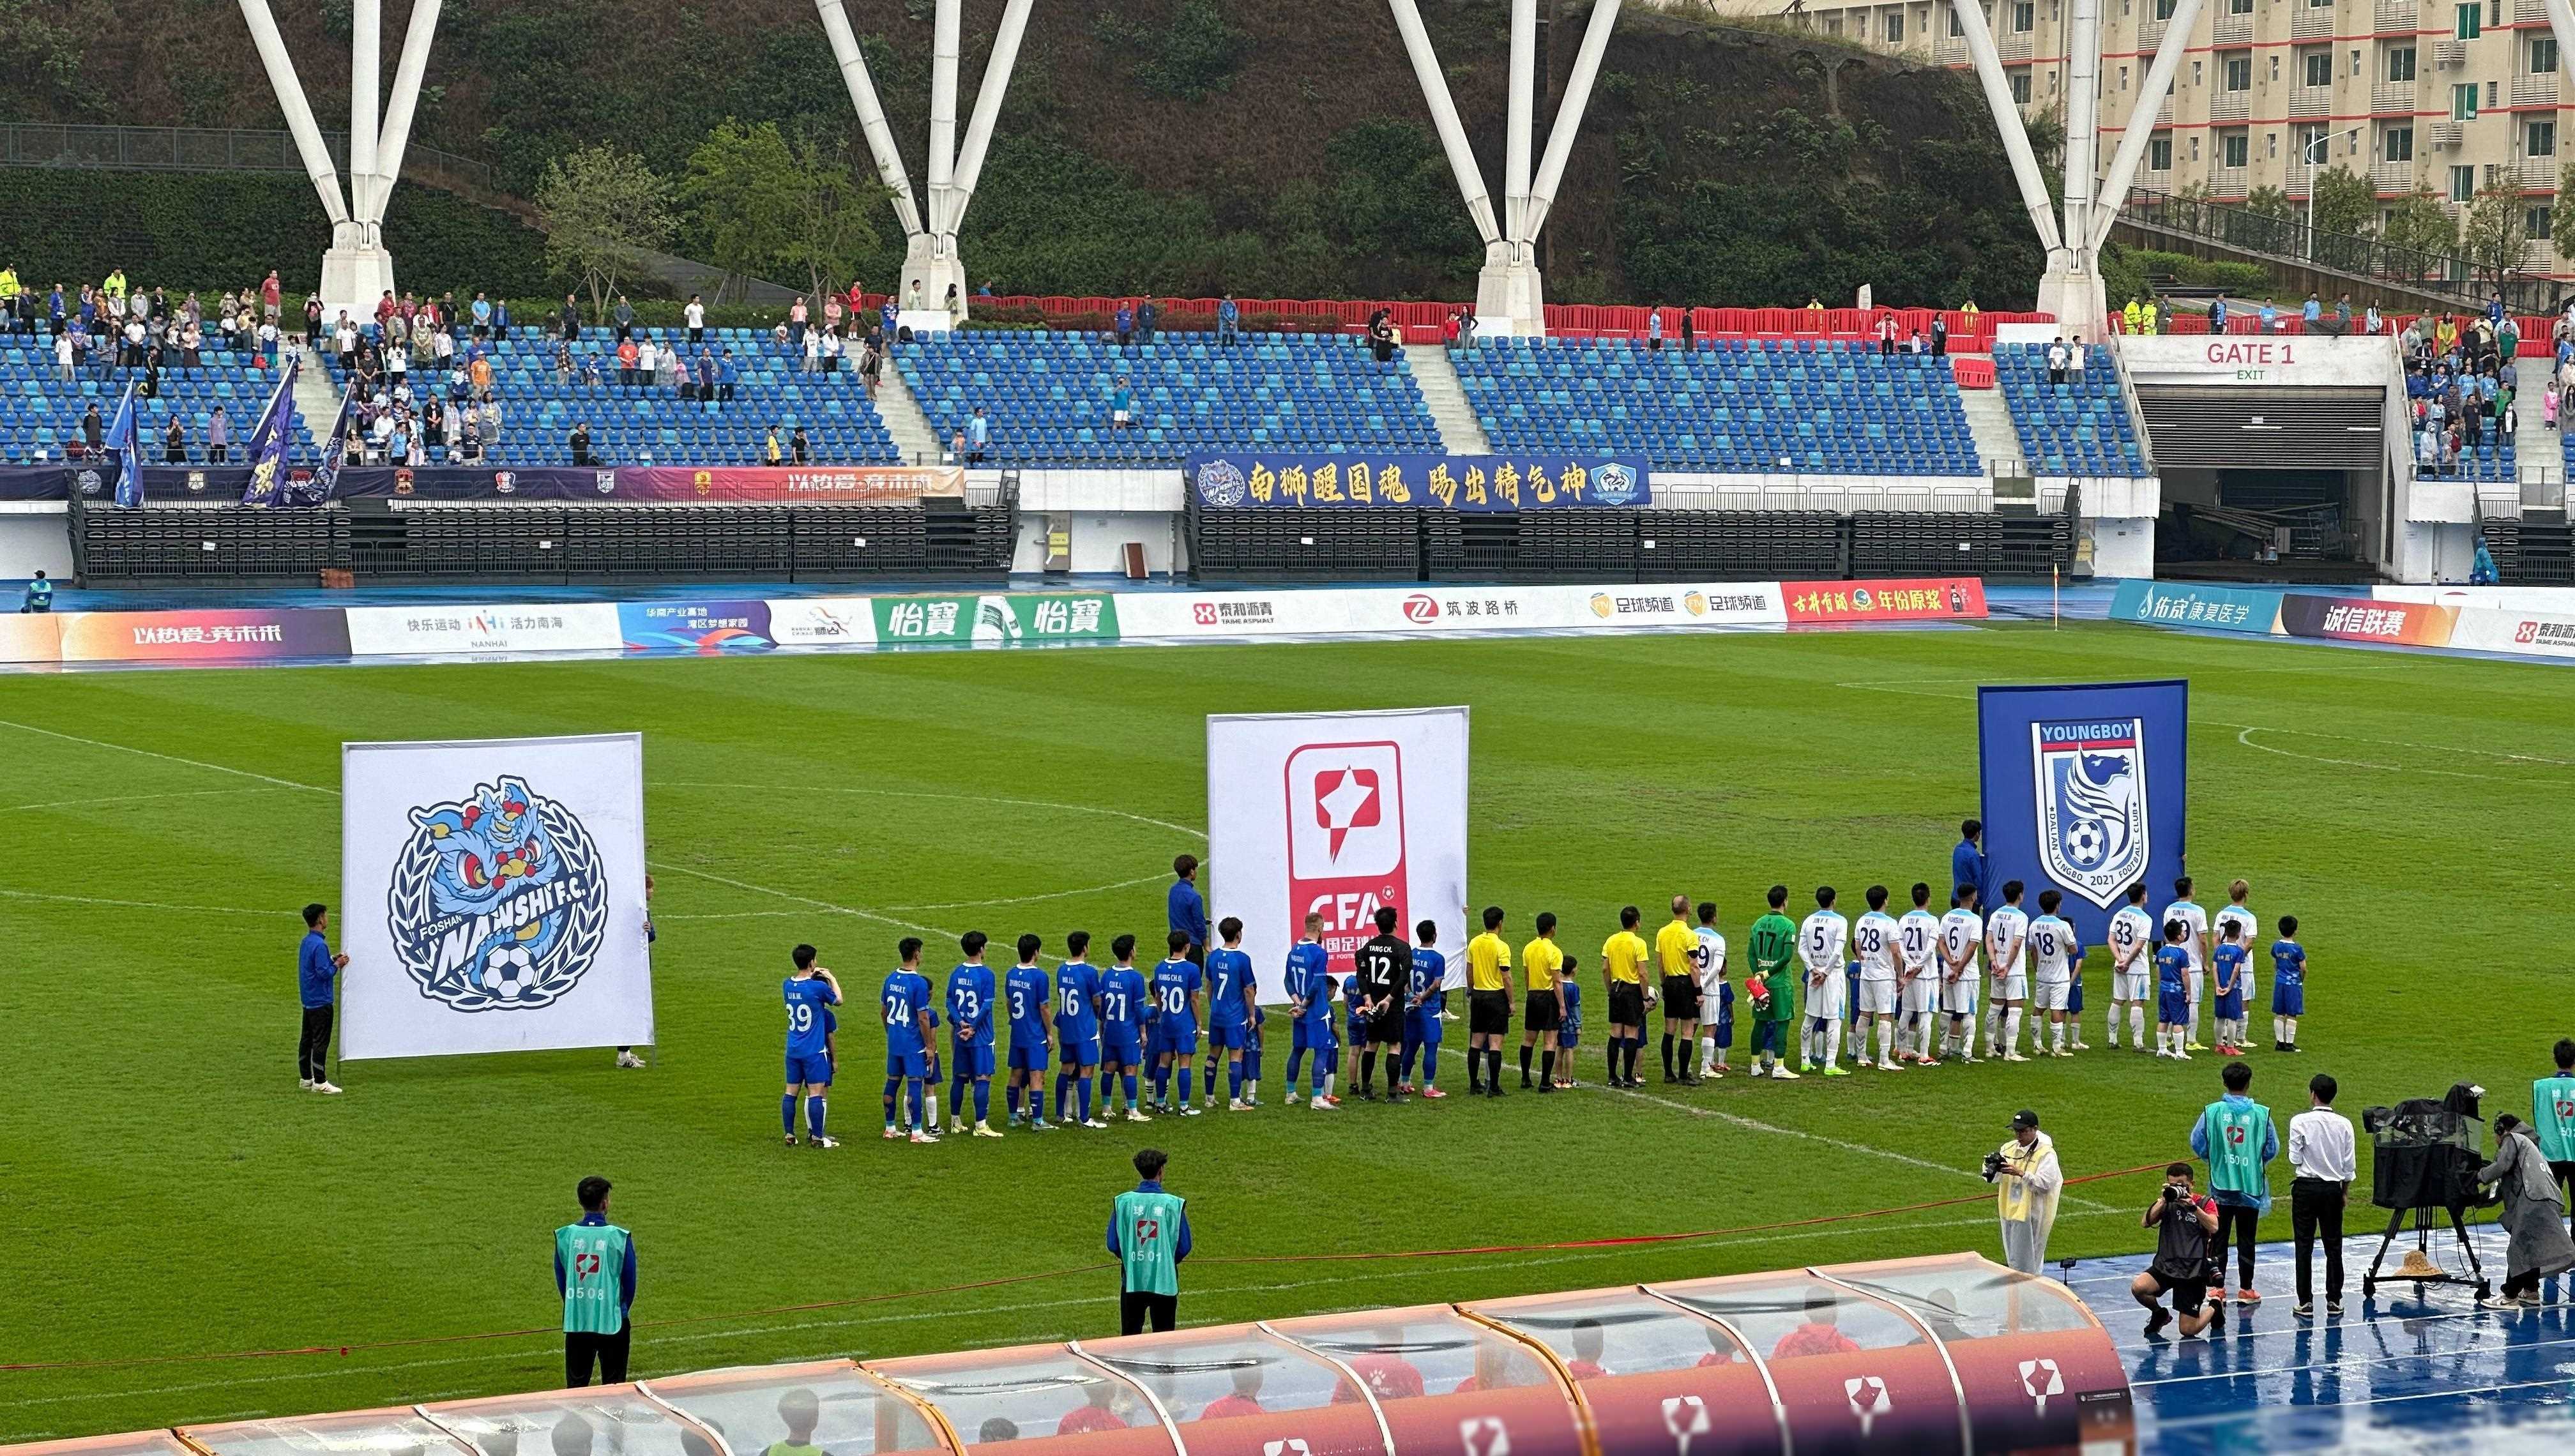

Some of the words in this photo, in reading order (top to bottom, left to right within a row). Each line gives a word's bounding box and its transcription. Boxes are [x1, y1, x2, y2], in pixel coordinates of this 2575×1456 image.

[2207, 343, 2272, 364] GATE
[2281, 344, 2295, 364] 1
[2237, 370, 2265, 381] EXIT
[1218, 602, 1272, 617] 泰和沥青
[1446, 600, 1518, 616] 筑波路桥
[1616, 596, 1675, 612] 足球频道
[1709, 595, 1767, 611] 足球频道
[1878, 588, 1943, 611] 年份原浆
[407, 618, 460, 632] 快乐运动
[510, 616, 563, 630] 活力南海
[888, 602, 959, 637] 怡寶
[1033, 599, 1102, 633] 怡寶
[2187, 601, 2249, 624] 康复医学
[2322, 605, 2406, 637] 诚信联赛
[2538, 623, 2575, 639] 泰和沥
[471, 640, 507, 648] NANHAI
[2042, 723, 2133, 741] YOUNGBOY
[2049, 812, 2058, 851] DALIAN
[2054, 853, 2083, 881] YINGBO
[2090, 875, 2115, 886] 2021
[2118, 838, 2141, 879] FOOTBALL
[1309, 892, 1383, 932] CFA
[419, 915, 462, 941] FOSHAN
[429, 883, 554, 985] NANSHI
[1813, 927, 1825, 951] 5
[1860, 927, 1881, 952] 28
[1905, 927, 1923, 952] 21
[1949, 926, 1959, 950] 6
[1998, 922, 2006, 946] 4
[2116, 920, 2133, 946] 33
[1758, 930, 1777, 957] 17
[2035, 932, 2055, 957] 18
[1291, 966, 1307, 996] 17
[1369, 956, 1391, 985] 12
[1409, 969, 1426, 994] 13
[1160, 985, 1185, 1014] 30
[1217, 973, 1229, 1001] 7
[886, 996, 910, 1028] 24
[955, 989, 979, 1019] 23
[1012, 991, 1025, 1020] 3
[1059, 987, 1079, 1017] 16
[1105, 992, 1126, 1022] 21
[786, 1003, 812, 1032] 39
[1132, 1250, 1162, 1263] 0501
[566, 1287, 604, 1301] 0508
